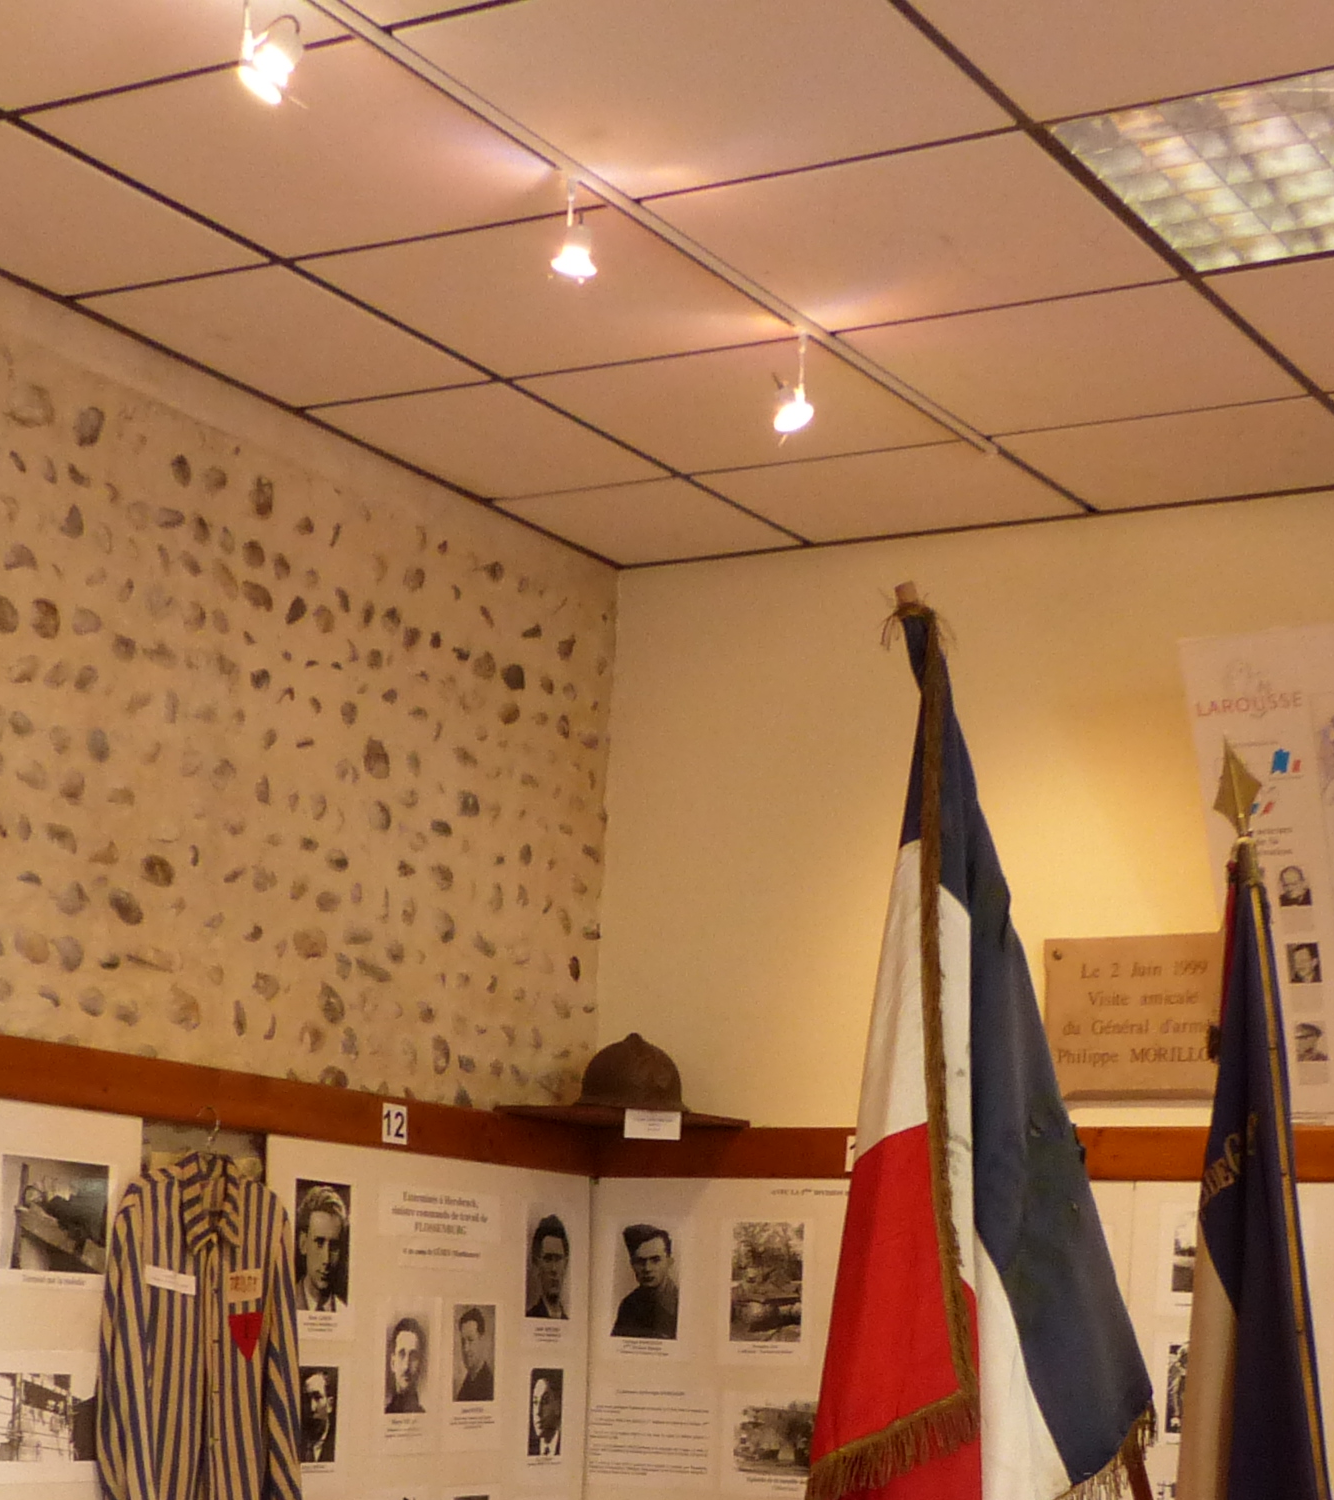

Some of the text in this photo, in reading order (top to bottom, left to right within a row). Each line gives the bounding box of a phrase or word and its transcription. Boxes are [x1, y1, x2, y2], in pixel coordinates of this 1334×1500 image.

[1196, 692, 1303, 717] LAROUSSE
[1080, 959, 1210, 979] Le 2 Juin 1999
[1088, 989, 1200, 1007] Visite amicale
[1062, 1018, 1210, 1036] du Général d'arm
[1056, 1046, 1210, 1068] Philippe MORILLO
[383, 1109, 405, 1138] 12
